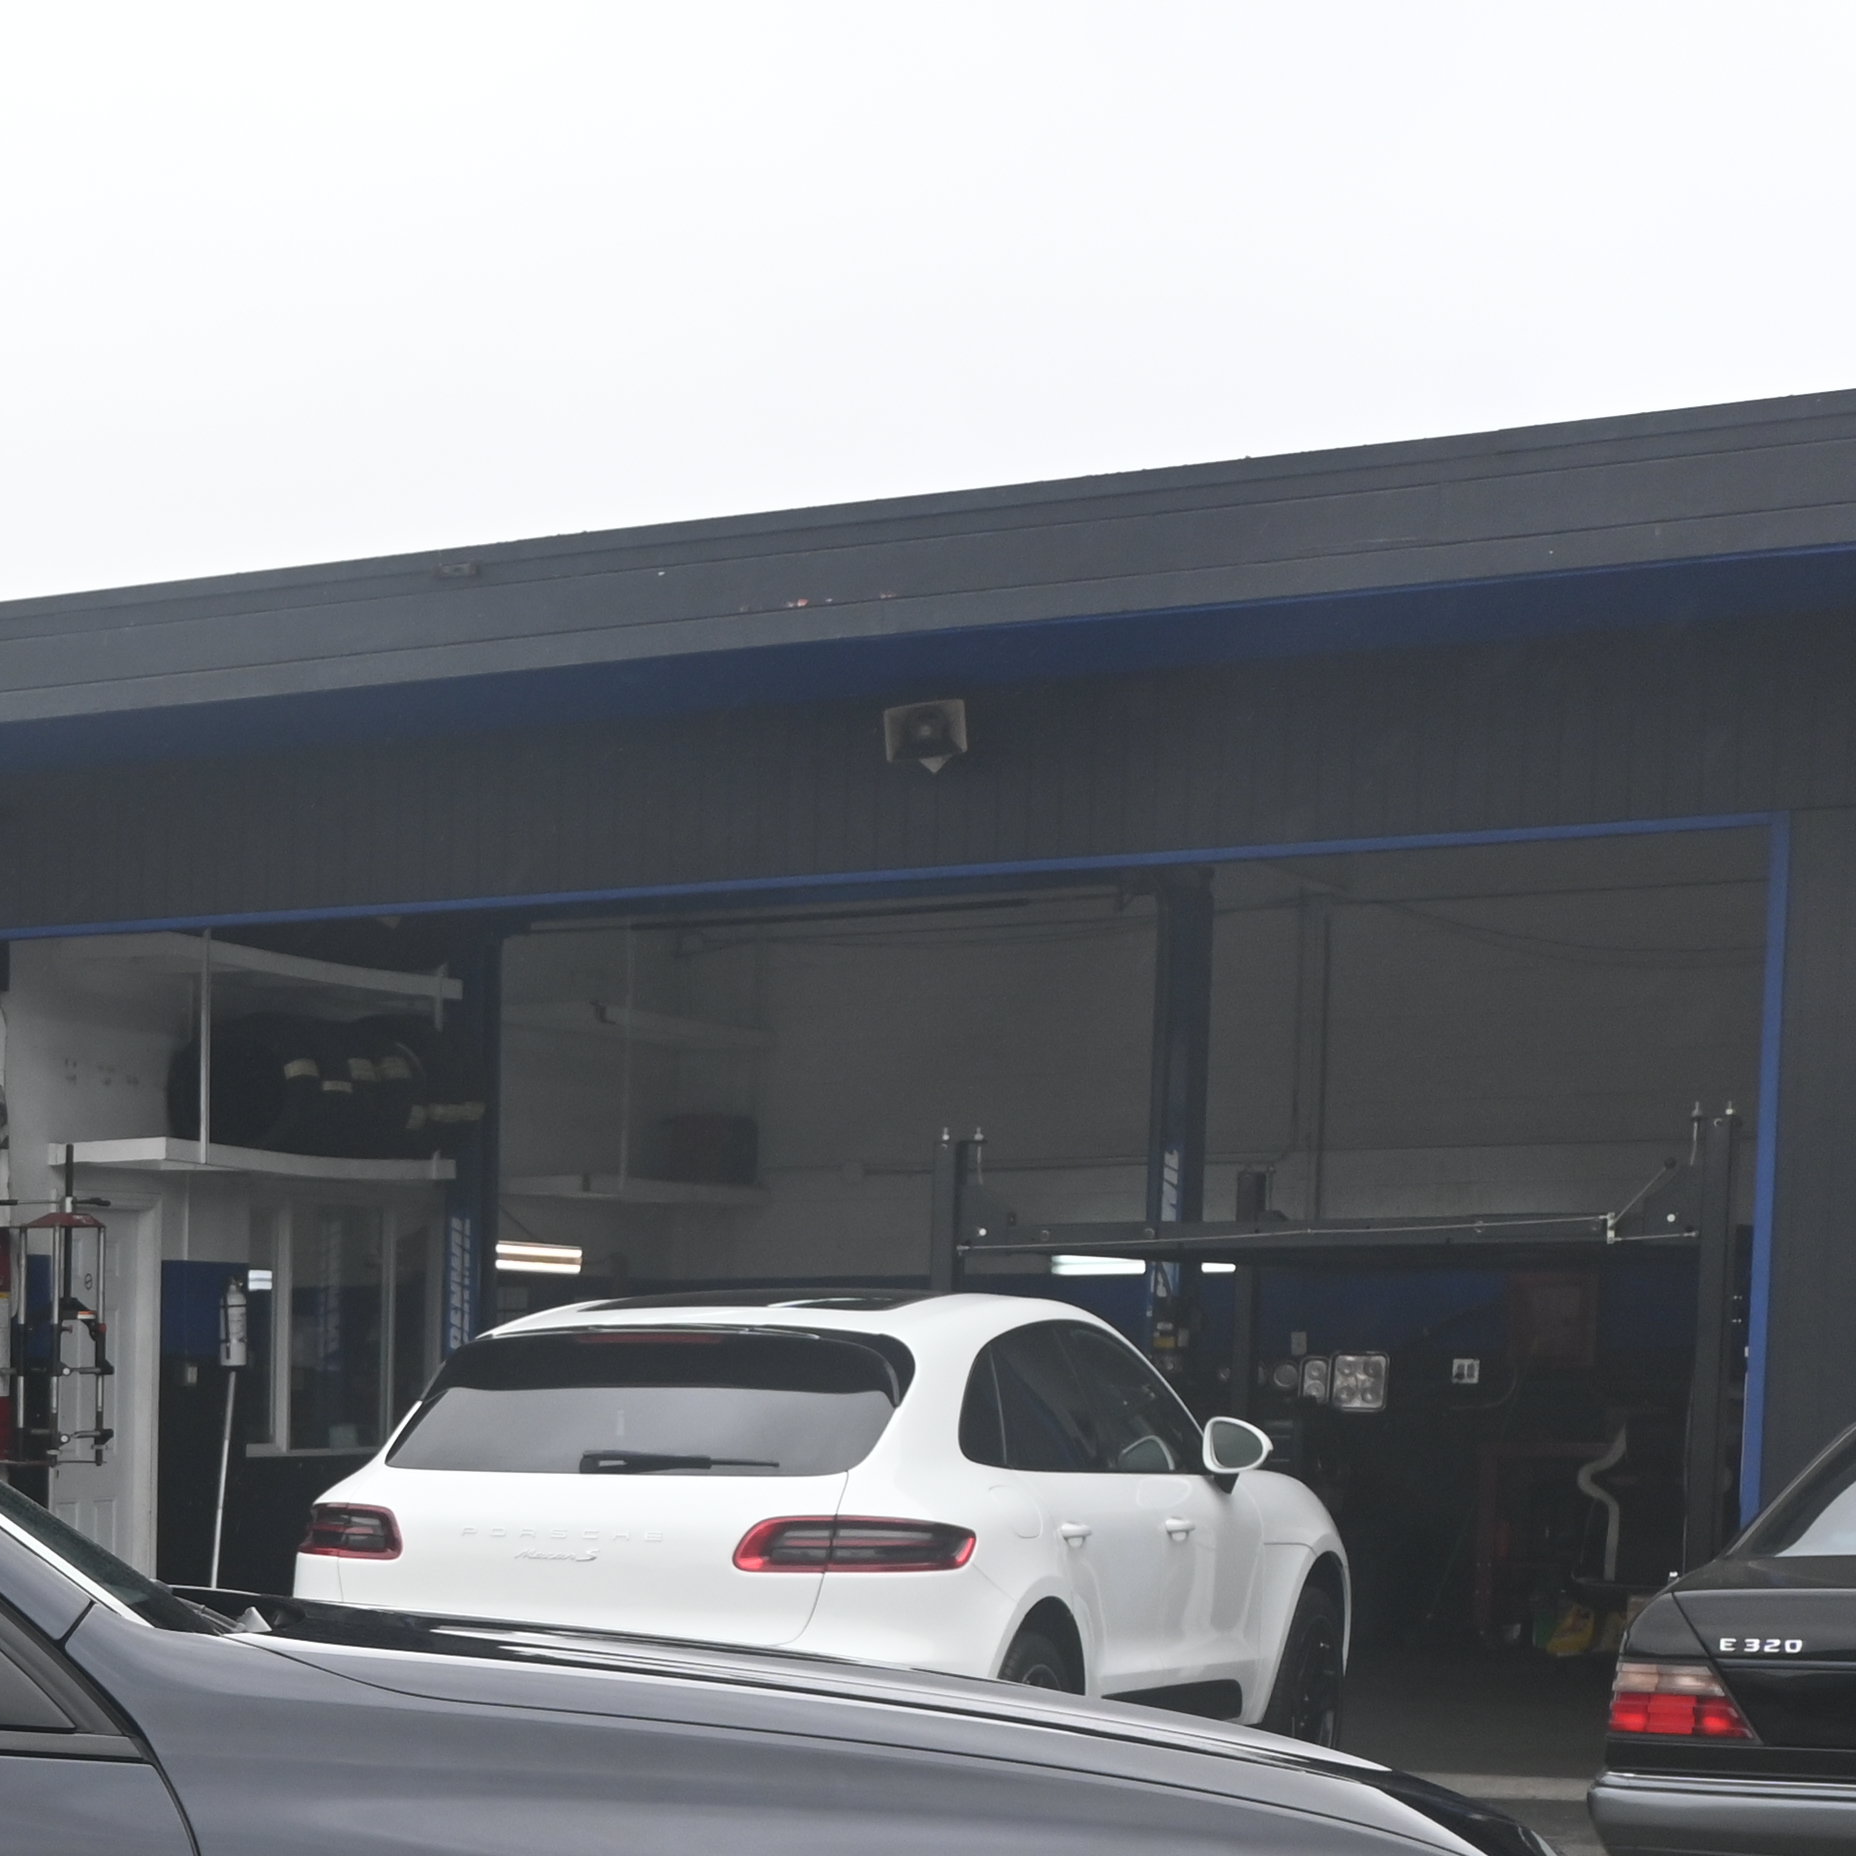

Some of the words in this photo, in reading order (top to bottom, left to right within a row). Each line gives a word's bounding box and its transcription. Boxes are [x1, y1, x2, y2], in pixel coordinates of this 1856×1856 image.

[461, 1527, 663, 1542] PORSCHE
[514, 1549, 576, 1560] Macan
[1719, 1637, 1737, 1651] E
[1743, 1638, 1803, 1654] 320
